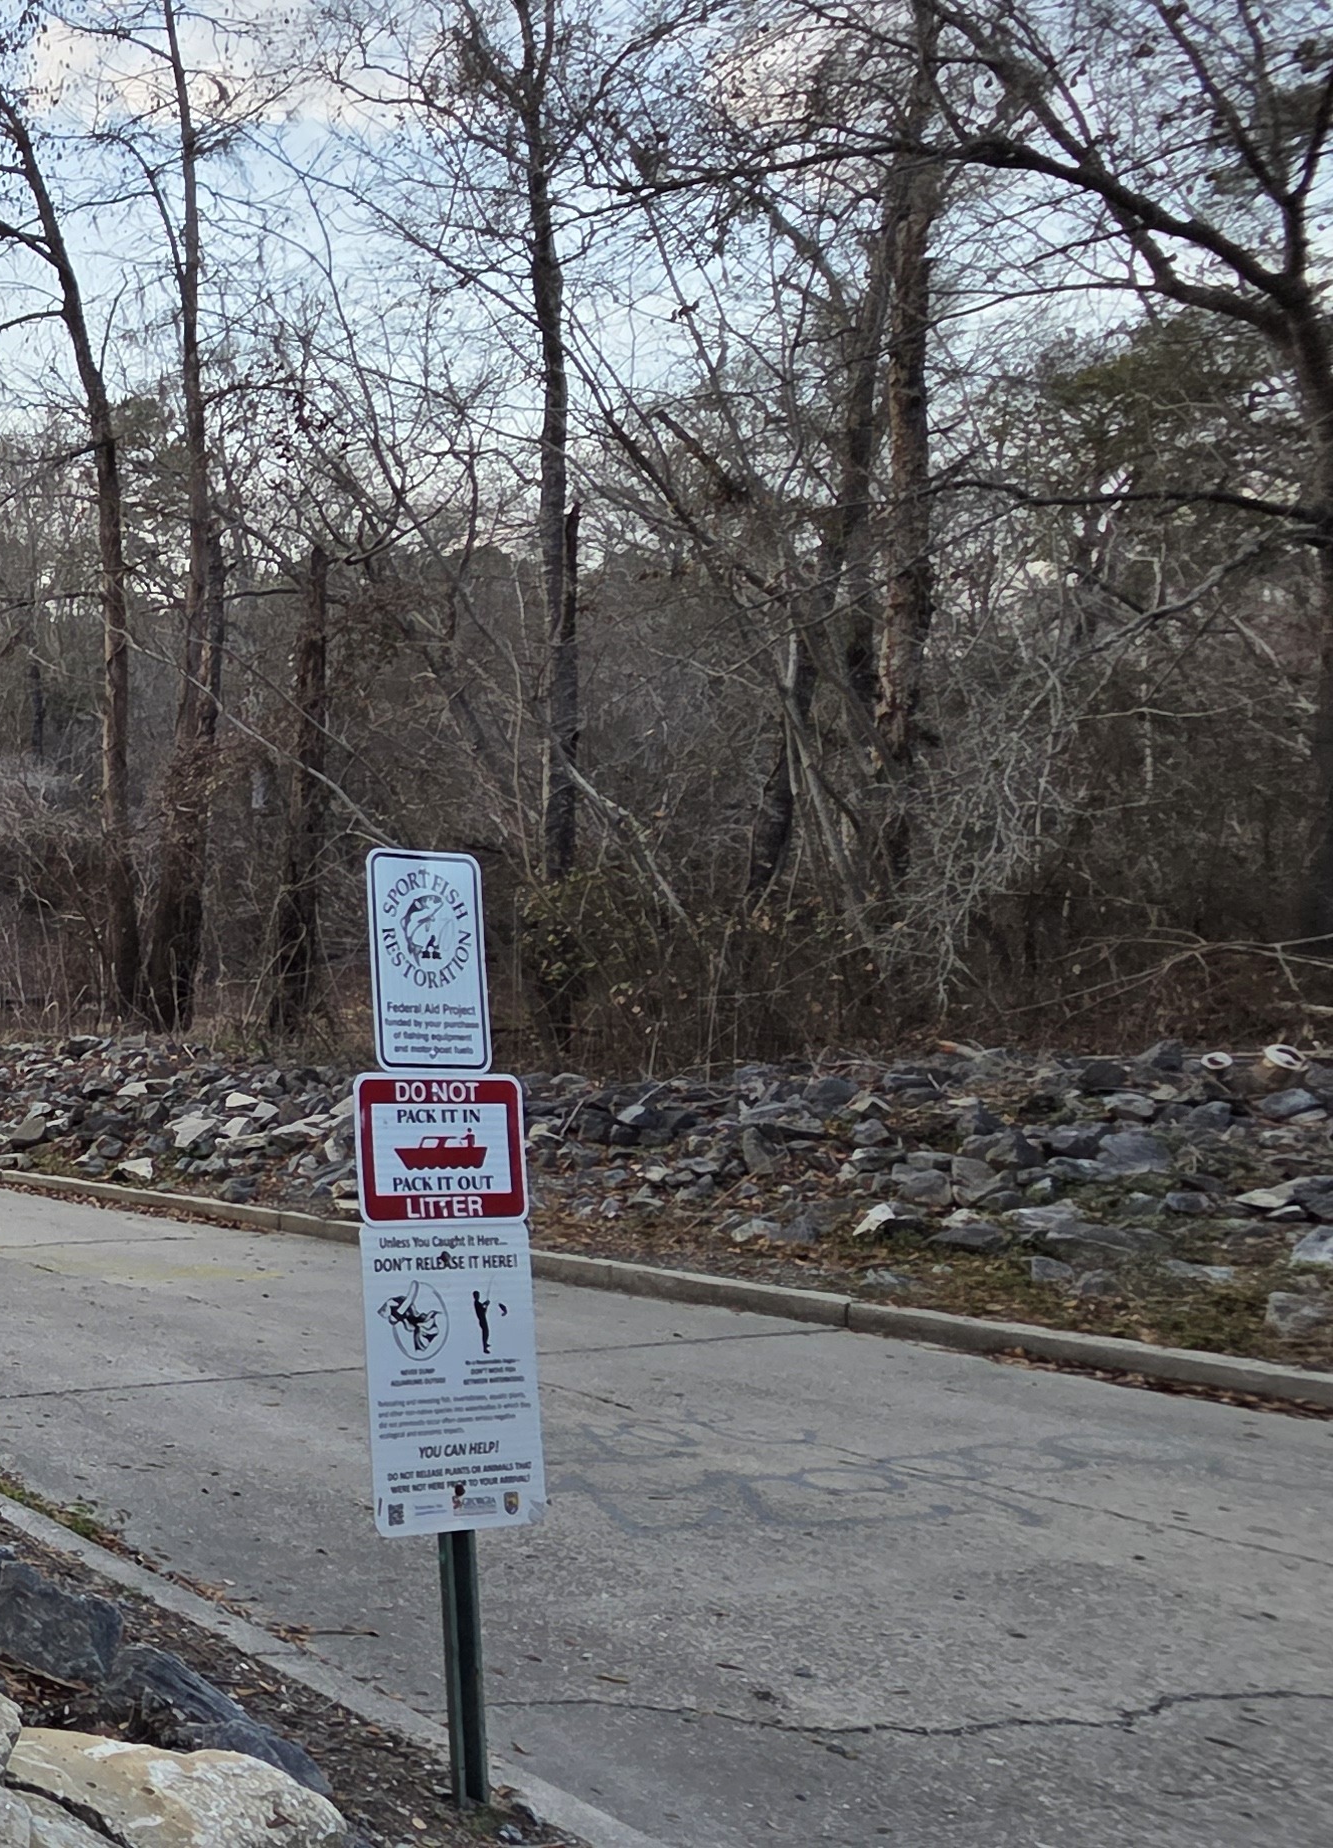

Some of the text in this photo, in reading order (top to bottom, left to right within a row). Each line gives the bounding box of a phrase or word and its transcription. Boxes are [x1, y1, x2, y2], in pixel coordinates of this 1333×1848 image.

[383, 868, 469, 920] SPORT FISH
[381, 927, 472, 989] RESTORATION
[387, 1001, 476, 1018] Federal Aid Project
[393, 1031, 402, 1040] of
[394, 1081, 480, 1103] DO NOT
[396, 1109, 481, 1124] PACK IT IN
[392, 1175, 494, 1192] PACK IT OUT
[406, 1196, 483, 1219] LITTER
[379, 1237, 410, 1249] Unless
[412, 1236, 430, 1248] You
[432, 1235, 466, 1249] Caught
[373, 1257, 413, 1273] DON'T
[468, 1255, 479, 1269] IT
[482, 1253, 518, 1269] HERE!
[418, 1440, 499, 1459] YOU CAN HELP!
[387, 1472, 399, 1481] DO
[444, 1466, 471, 1476] PLANTS
[468, 1479, 479, 1487] TO
